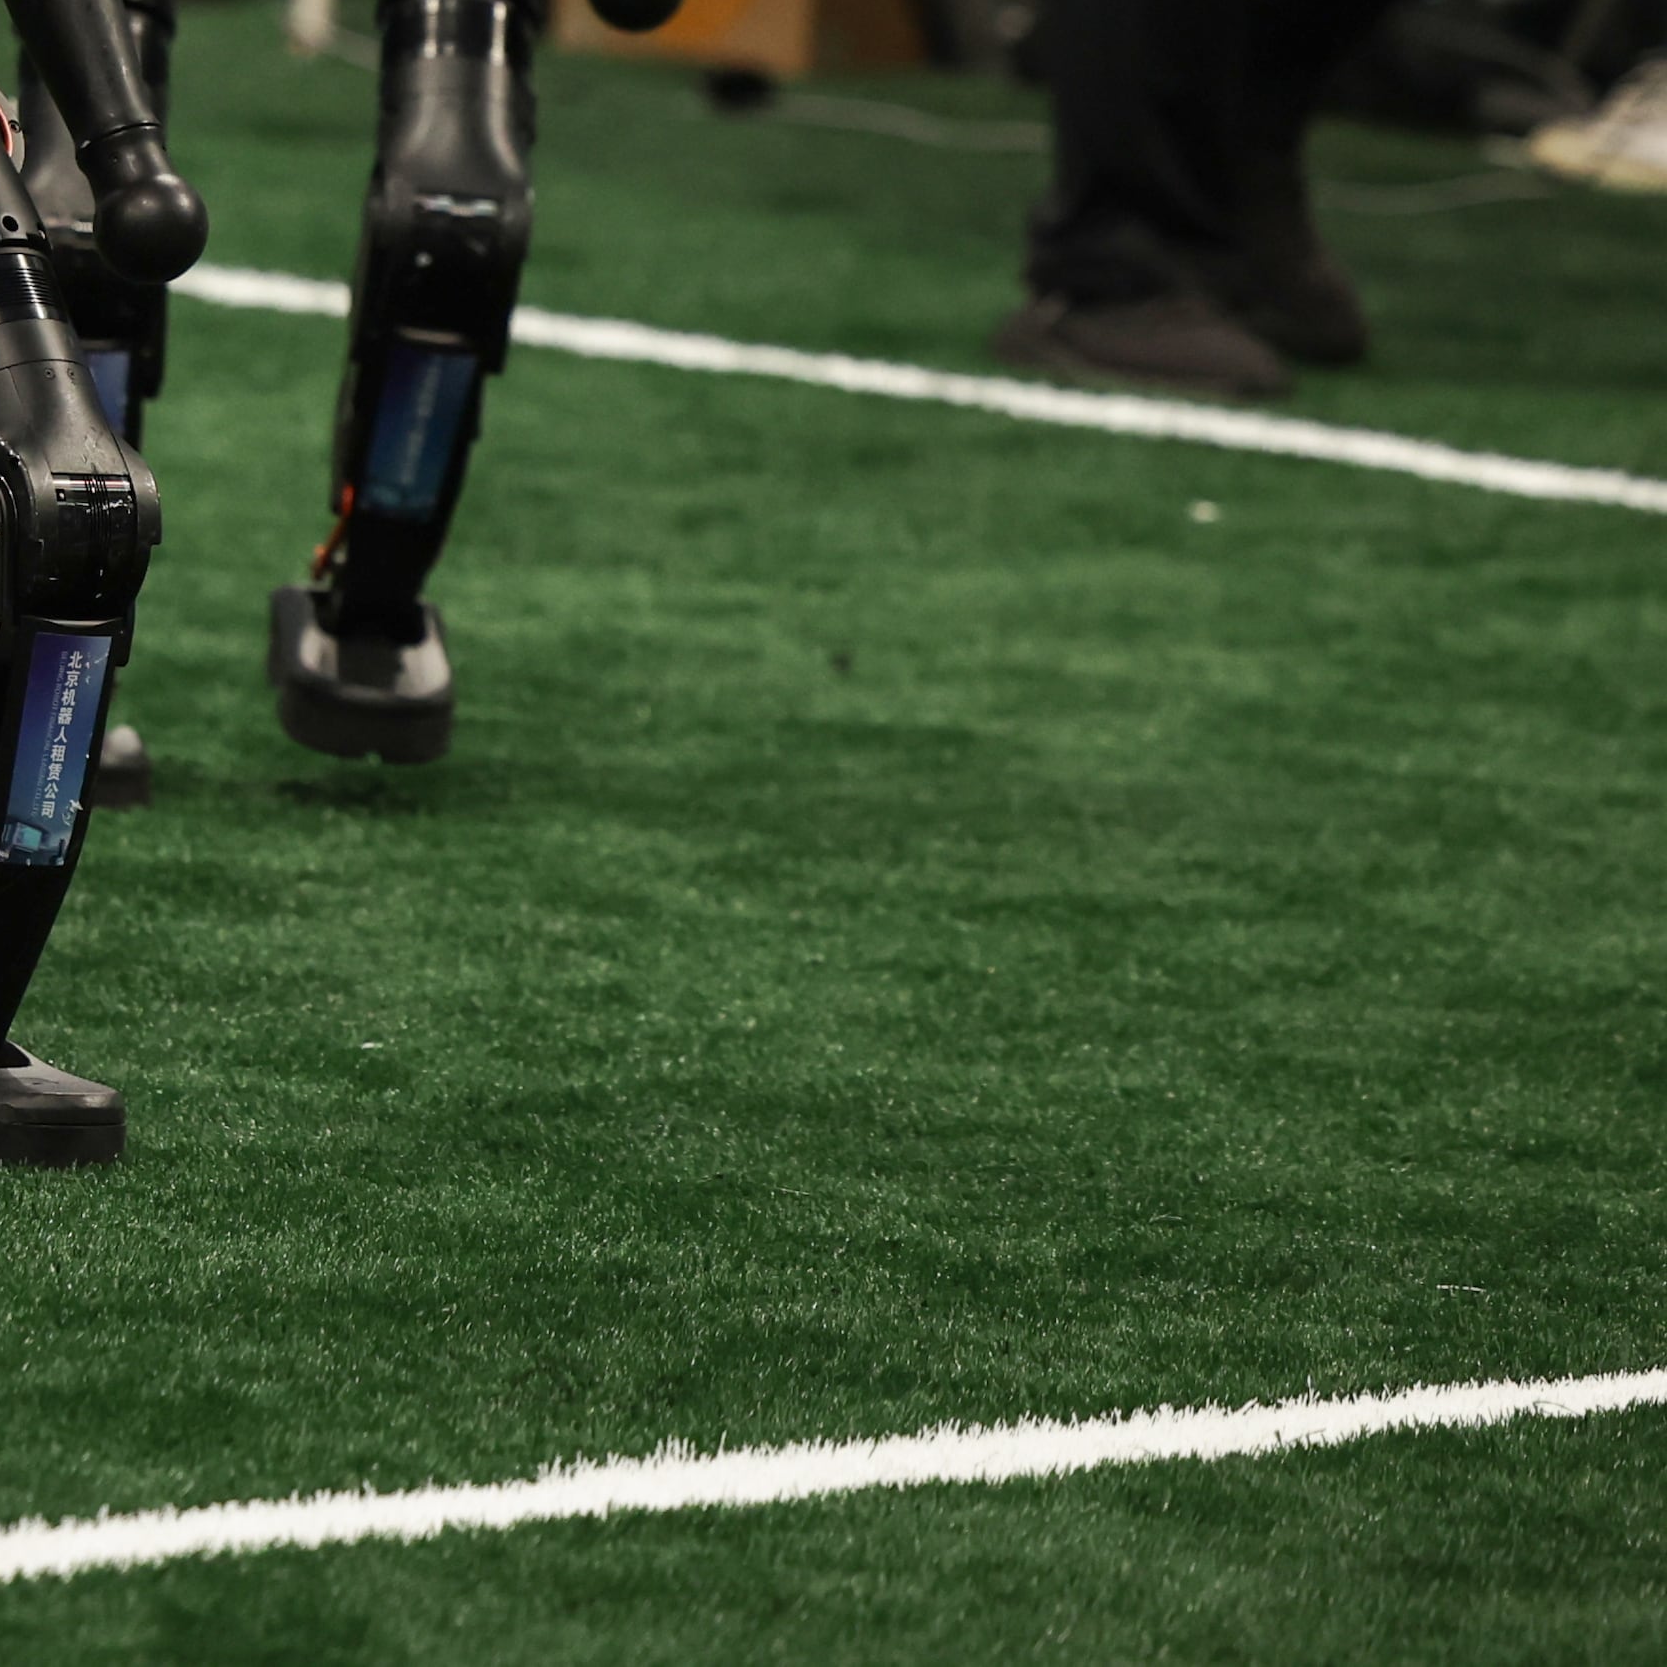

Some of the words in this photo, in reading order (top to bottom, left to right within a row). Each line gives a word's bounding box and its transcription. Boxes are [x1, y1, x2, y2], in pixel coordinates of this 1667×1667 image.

[41, 650, 83, 819] 北京机器人租赁公司
